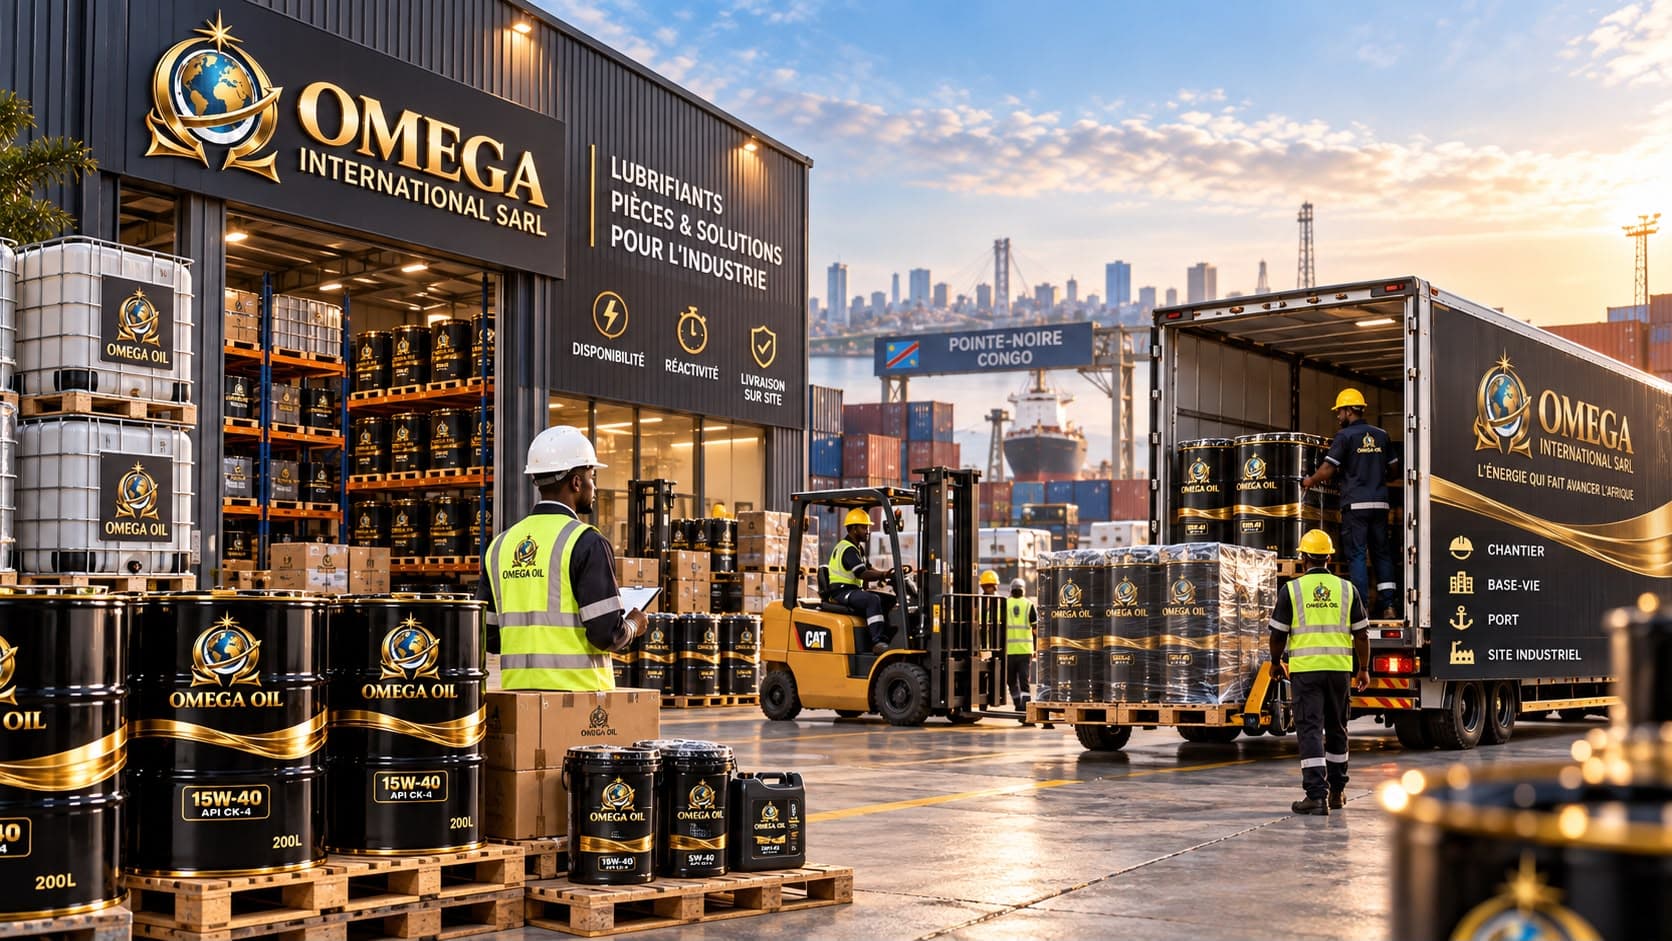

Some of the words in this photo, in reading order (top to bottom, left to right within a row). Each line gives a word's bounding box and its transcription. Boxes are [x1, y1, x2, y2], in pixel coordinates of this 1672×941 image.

[298, 81, 548, 208] OMEGA
[300, 147, 490, 222] INTERNATIONAL
[496, 204, 547, 237] SARL
[611, 155, 723, 215] LUBRIFIANTS
[611, 190, 674, 230] PIÈCES
[680, 214, 692, 236] &
[697, 219, 783, 265] SOLUTIONS
[611, 224, 663, 261] POUR
[669, 242, 767, 290] L'INDUSTRIE
[950, 330, 1063, 352] POINTE-NOIRE
[107, 343, 148, 361] OMEGA
[151, 348, 169, 364] OIL
[572, 342, 645, 367] DISPONIBILITÉ
[977, 350, 1033, 367] CONGO
[665, 357, 719, 381] RÉACTIVITÉ
[741, 373, 786, 393] LIVRAISON
[744, 388, 762, 402] SUR
[764, 391, 782, 406] SITE
[1538, 389, 1635, 455] OMEGA
[1540, 437, 1612, 471] INTERNATIONAL
[1614, 455, 1635, 474] SARL
[1206, 484, 1219, 493] OIL
[1236, 482, 1261, 491] OMEGA
[1263, 481, 1278, 490] OIL
[1478, 462, 1528, 485] L'ÉNERGIE
[1529, 472, 1545, 488] QUI
[1547, 474, 1565, 490] FAIT
[1566, 478, 1600, 496] AVANCER
[1602, 483, 1635, 501] L'AFRIQUE
[105, 521, 148, 536] OMEGA
[150, 523, 168, 537] OIL
[1488, 543, 1545, 558] CHANTIER
[502, 569, 531, 580] OMEGA
[531, 567, 544, 578] OIL
[1488, 579, 1541, 591] BASE-VIE
[1051, 610, 1077, 618] OMEGA
[1079, 609, 1093, 618] OIL
[1105, 608, 1132, 617] OMEGA
[1134, 608, 1148, 617] OIL
[1162, 607, 1190, 617] OMEGA
[1192, 607, 1207, 616] OIL
[1488, 613, 1519, 626] PORT
[805, 630, 827, 649] CAT
[1488, 648, 1513, 661] SITE
[1516, 648, 1582, 661] INDUSTRIEL
[169, 691, 246, 709] OMEGA
[250, 690, 284, 709] OIL
[361, 684, 427, 700] OMEGA
[431, 683, 458, 699] OIL
[3, 710, 47, 731] OIL
[607, 728, 617, 736] OIL
[382, 774, 441, 791] 15W-40
[191, 790, 262, 808] 15W-40
[390, 791, 408, 800] API
[409, 790, 432, 800] CK-4
[201, 808, 221, 818] API
[224, 807, 251, 818] CK-4
[589, 812, 627, 821] OMEGA
[630, 812, 646, 821] OIL
[677, 811, 710, 820] OMEGA
[711, 810, 724, 819] OIL
[450, 816, 474, 829] 200L
[272, 835, 302, 849] 200L
[35, 873, 76, 890] 200L
